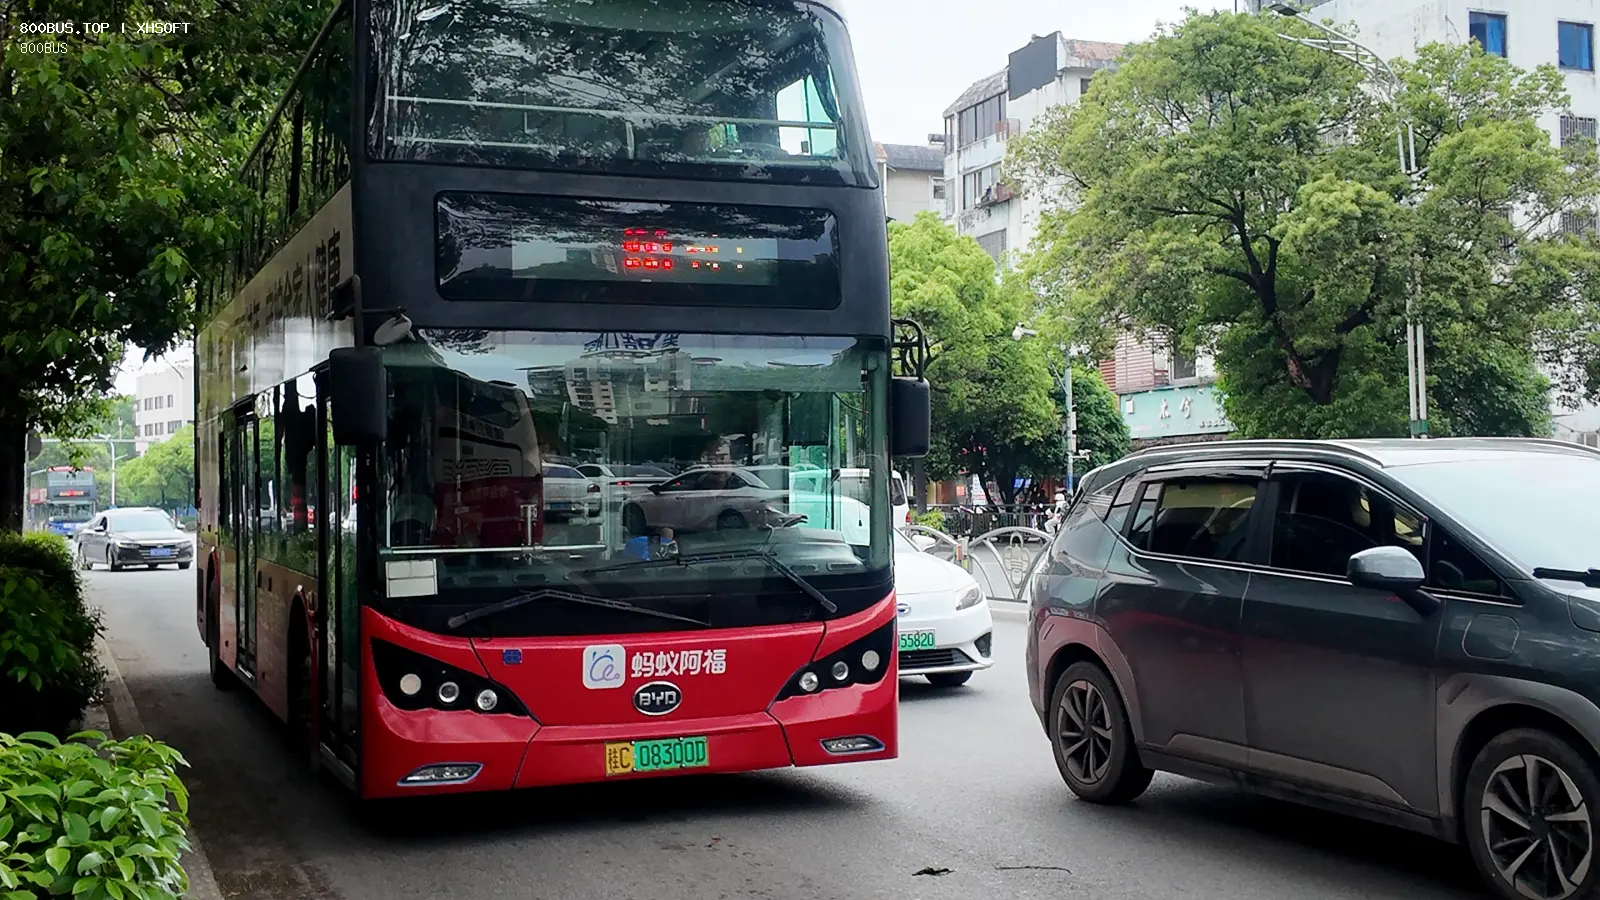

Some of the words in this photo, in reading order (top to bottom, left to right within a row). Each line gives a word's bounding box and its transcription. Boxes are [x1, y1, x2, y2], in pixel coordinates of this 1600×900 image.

[898, 632, 934, 648] 55820
[631, 649, 726, 678] 蚂蚁阿福
[639, 691, 676, 706] BYD
